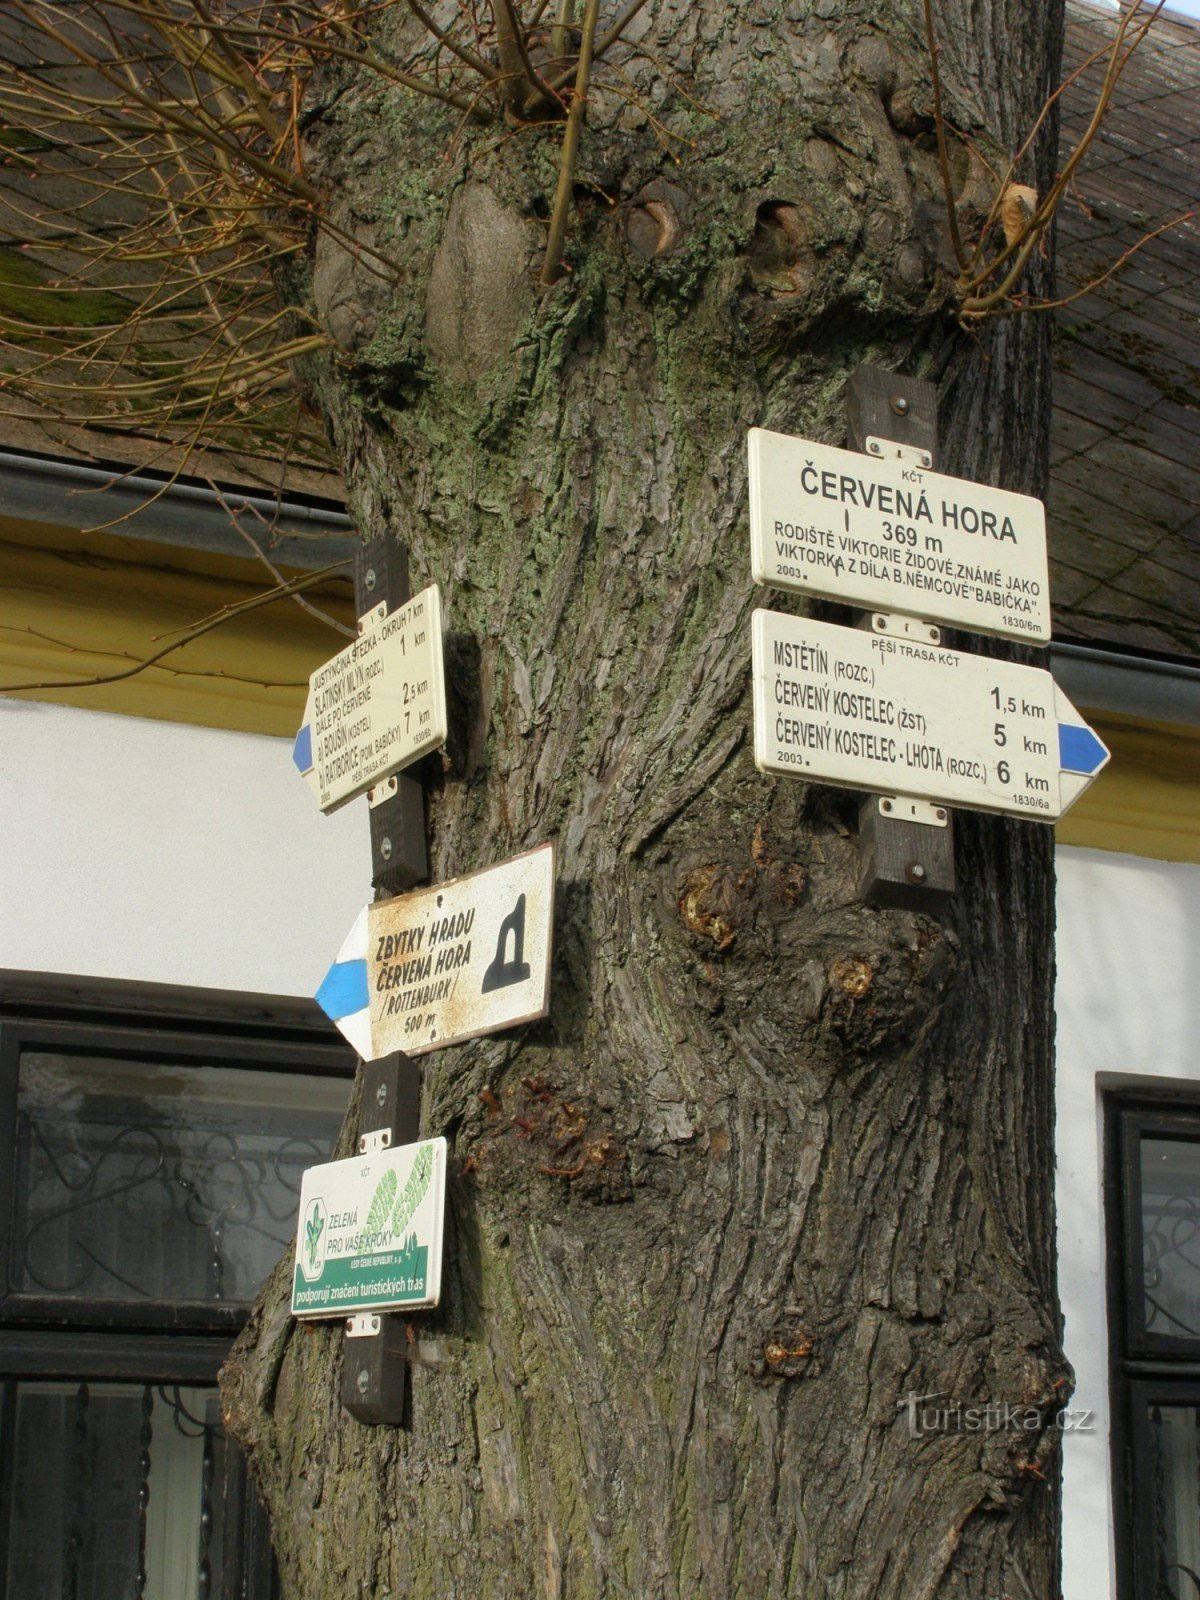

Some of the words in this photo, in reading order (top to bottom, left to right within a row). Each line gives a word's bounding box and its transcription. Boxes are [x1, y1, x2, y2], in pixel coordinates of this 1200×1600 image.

[902, 470, 923, 484] KČT
[801, 460, 933, 524] ČERVENÁ
[941, 501, 1018, 544] HORA
[882, 521, 917, 547] 369
[926, 535, 942, 552] m
[774, 521, 834, 548] RODIŠTĚ
[838, 536, 901, 562] VIKTORIE
[1006, 578, 1040, 596] JAKO
[776, 541, 844, 572] VIKTORKA
[849, 559, 857, 573] Z
[860, 560, 890, 580] DÍLA
[382, 611, 406, 640] OKRUH
[407, 608, 412, 623] 7
[413, 603, 424, 618] km
[1002, 616, 1042, 632] 1830/6m
[872, 639, 896, 654] PĚŠÍ
[900, 645, 934, 663] TRASA
[938, 651, 960, 667] KČT
[314, 673, 346, 717] SLATINSKÝ
[345, 662, 365, 695] MLÝN
[400, 634, 406, 656] 1
[414, 631, 425, 647] km
[774, 640, 828, 674] MSTĚTÍN
[834, 660, 875, 688] (ROZC.)
[990, 687, 1016, 714] 1,5
[1021, 700, 1046, 719] km
[316, 712, 332, 735] DÁLE
[333, 707, 341, 724] PO
[342, 686, 371, 718] ČERVENÉ
[324, 722, 347, 757] BOUŠÍN
[348, 715, 371, 746] (KOSTEL)
[402, 682, 415, 705] 2,5
[416, 679, 428, 696] km
[775, 674, 830, 710] ČERVENÝ
[834, 691, 894, 725] KOSTELEC
[897, 709, 926, 735] (ŽST)
[994, 724, 1006, 747] 5
[1024, 736, 1047, 755] km
[375, 725, 401, 755] BABIČKY)
[404, 711, 411, 734] 7
[418, 709, 430, 726] km
[363, 761, 378, 776] TRASA
[379, 753, 390, 769] KČT
[776, 714, 830, 751] ČERVENÝ
[835, 729, 896, 764] KOSTELEC
[906, 742, 943, 771] LHOTA
[947, 757, 987, 783] (ROZC.)
[997, 761, 1010, 784] 6
[1025, 773, 1049, 791] km
[1012, 794, 1049, 810] 1830/6a
[375, 926, 425, 962] ZBYTKY
[429, 908, 475, 946] HRADU
[377, 949, 433, 992] ČERVENÁ
[435, 941, 472, 972] HORA
[404, 1016, 422, 1033] 500
[425, 1013, 435, 1027] m
[361, 1166, 370, 1177] KČT
[329, 1207, 358, 1230] ZELENÁ
[327, 1240, 342, 1254] PRO
[344, 1233, 366, 1251] VAŠE
[365, 1231, 394, 1247] KROKY
[297, 1286, 329, 1305] podporují
[331, 1281, 359, 1300] značení
[361, 1275, 405, 1297] turistických
[408, 1276, 423, 1292] tras
